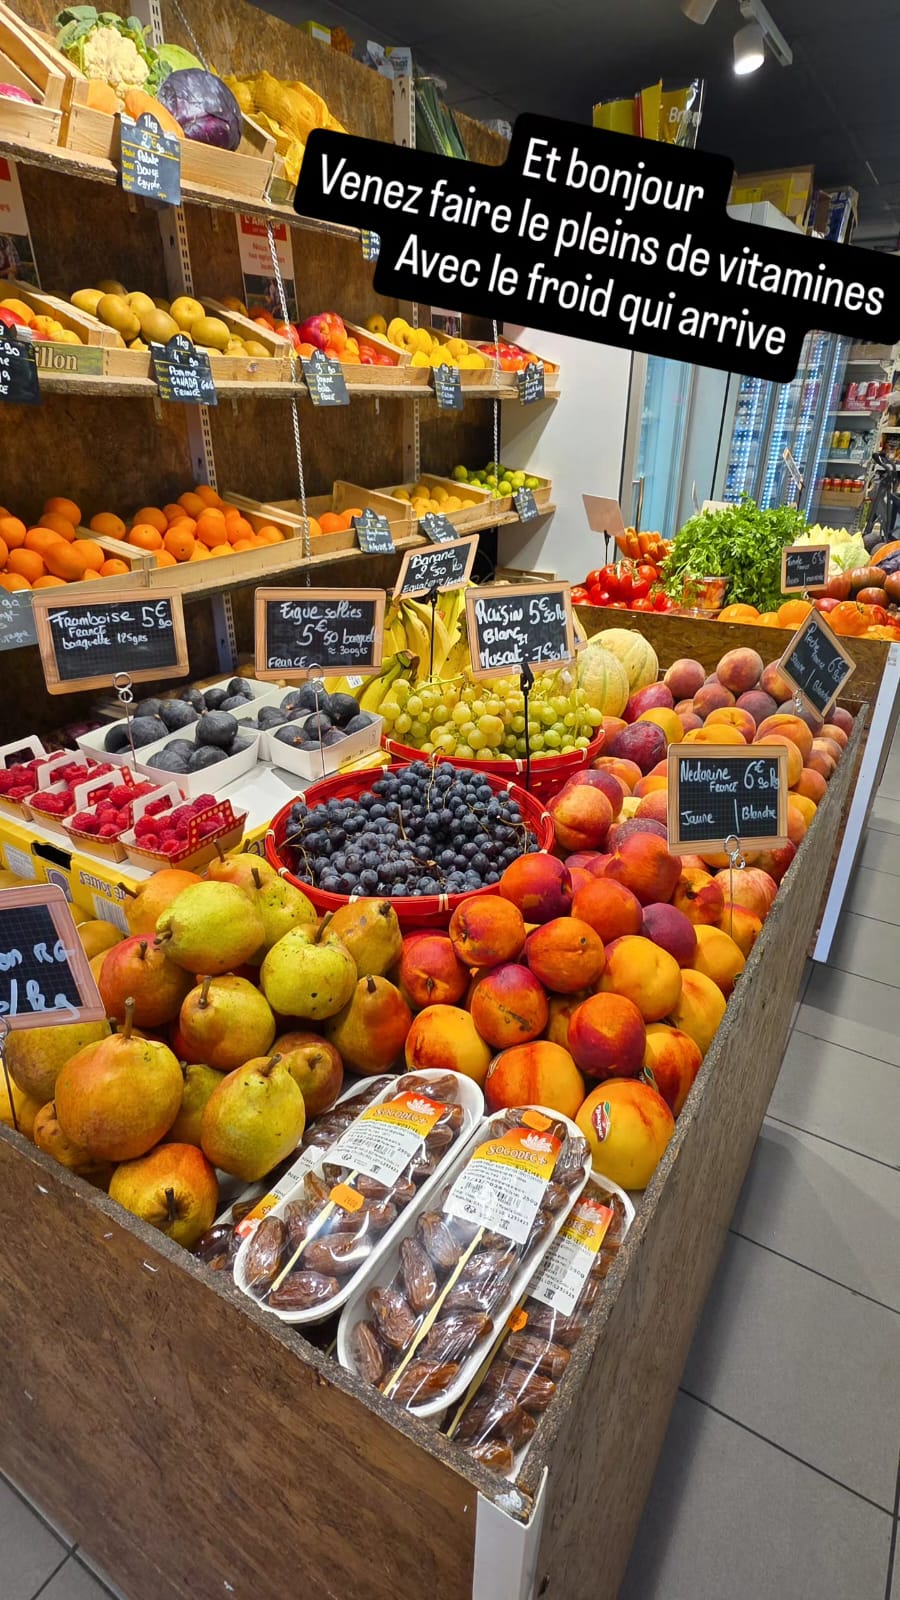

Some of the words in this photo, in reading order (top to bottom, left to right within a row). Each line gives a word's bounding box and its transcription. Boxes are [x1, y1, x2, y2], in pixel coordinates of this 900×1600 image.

[411, 549, 457, 569] Banane
[46, 610, 136, 628] Framboise
[280, 602, 323, 626] Figue
[482, 626, 521, 645] Blanc
[680, 760, 731, 783] Nectarine
[680, 810, 716, 826] Jaune
